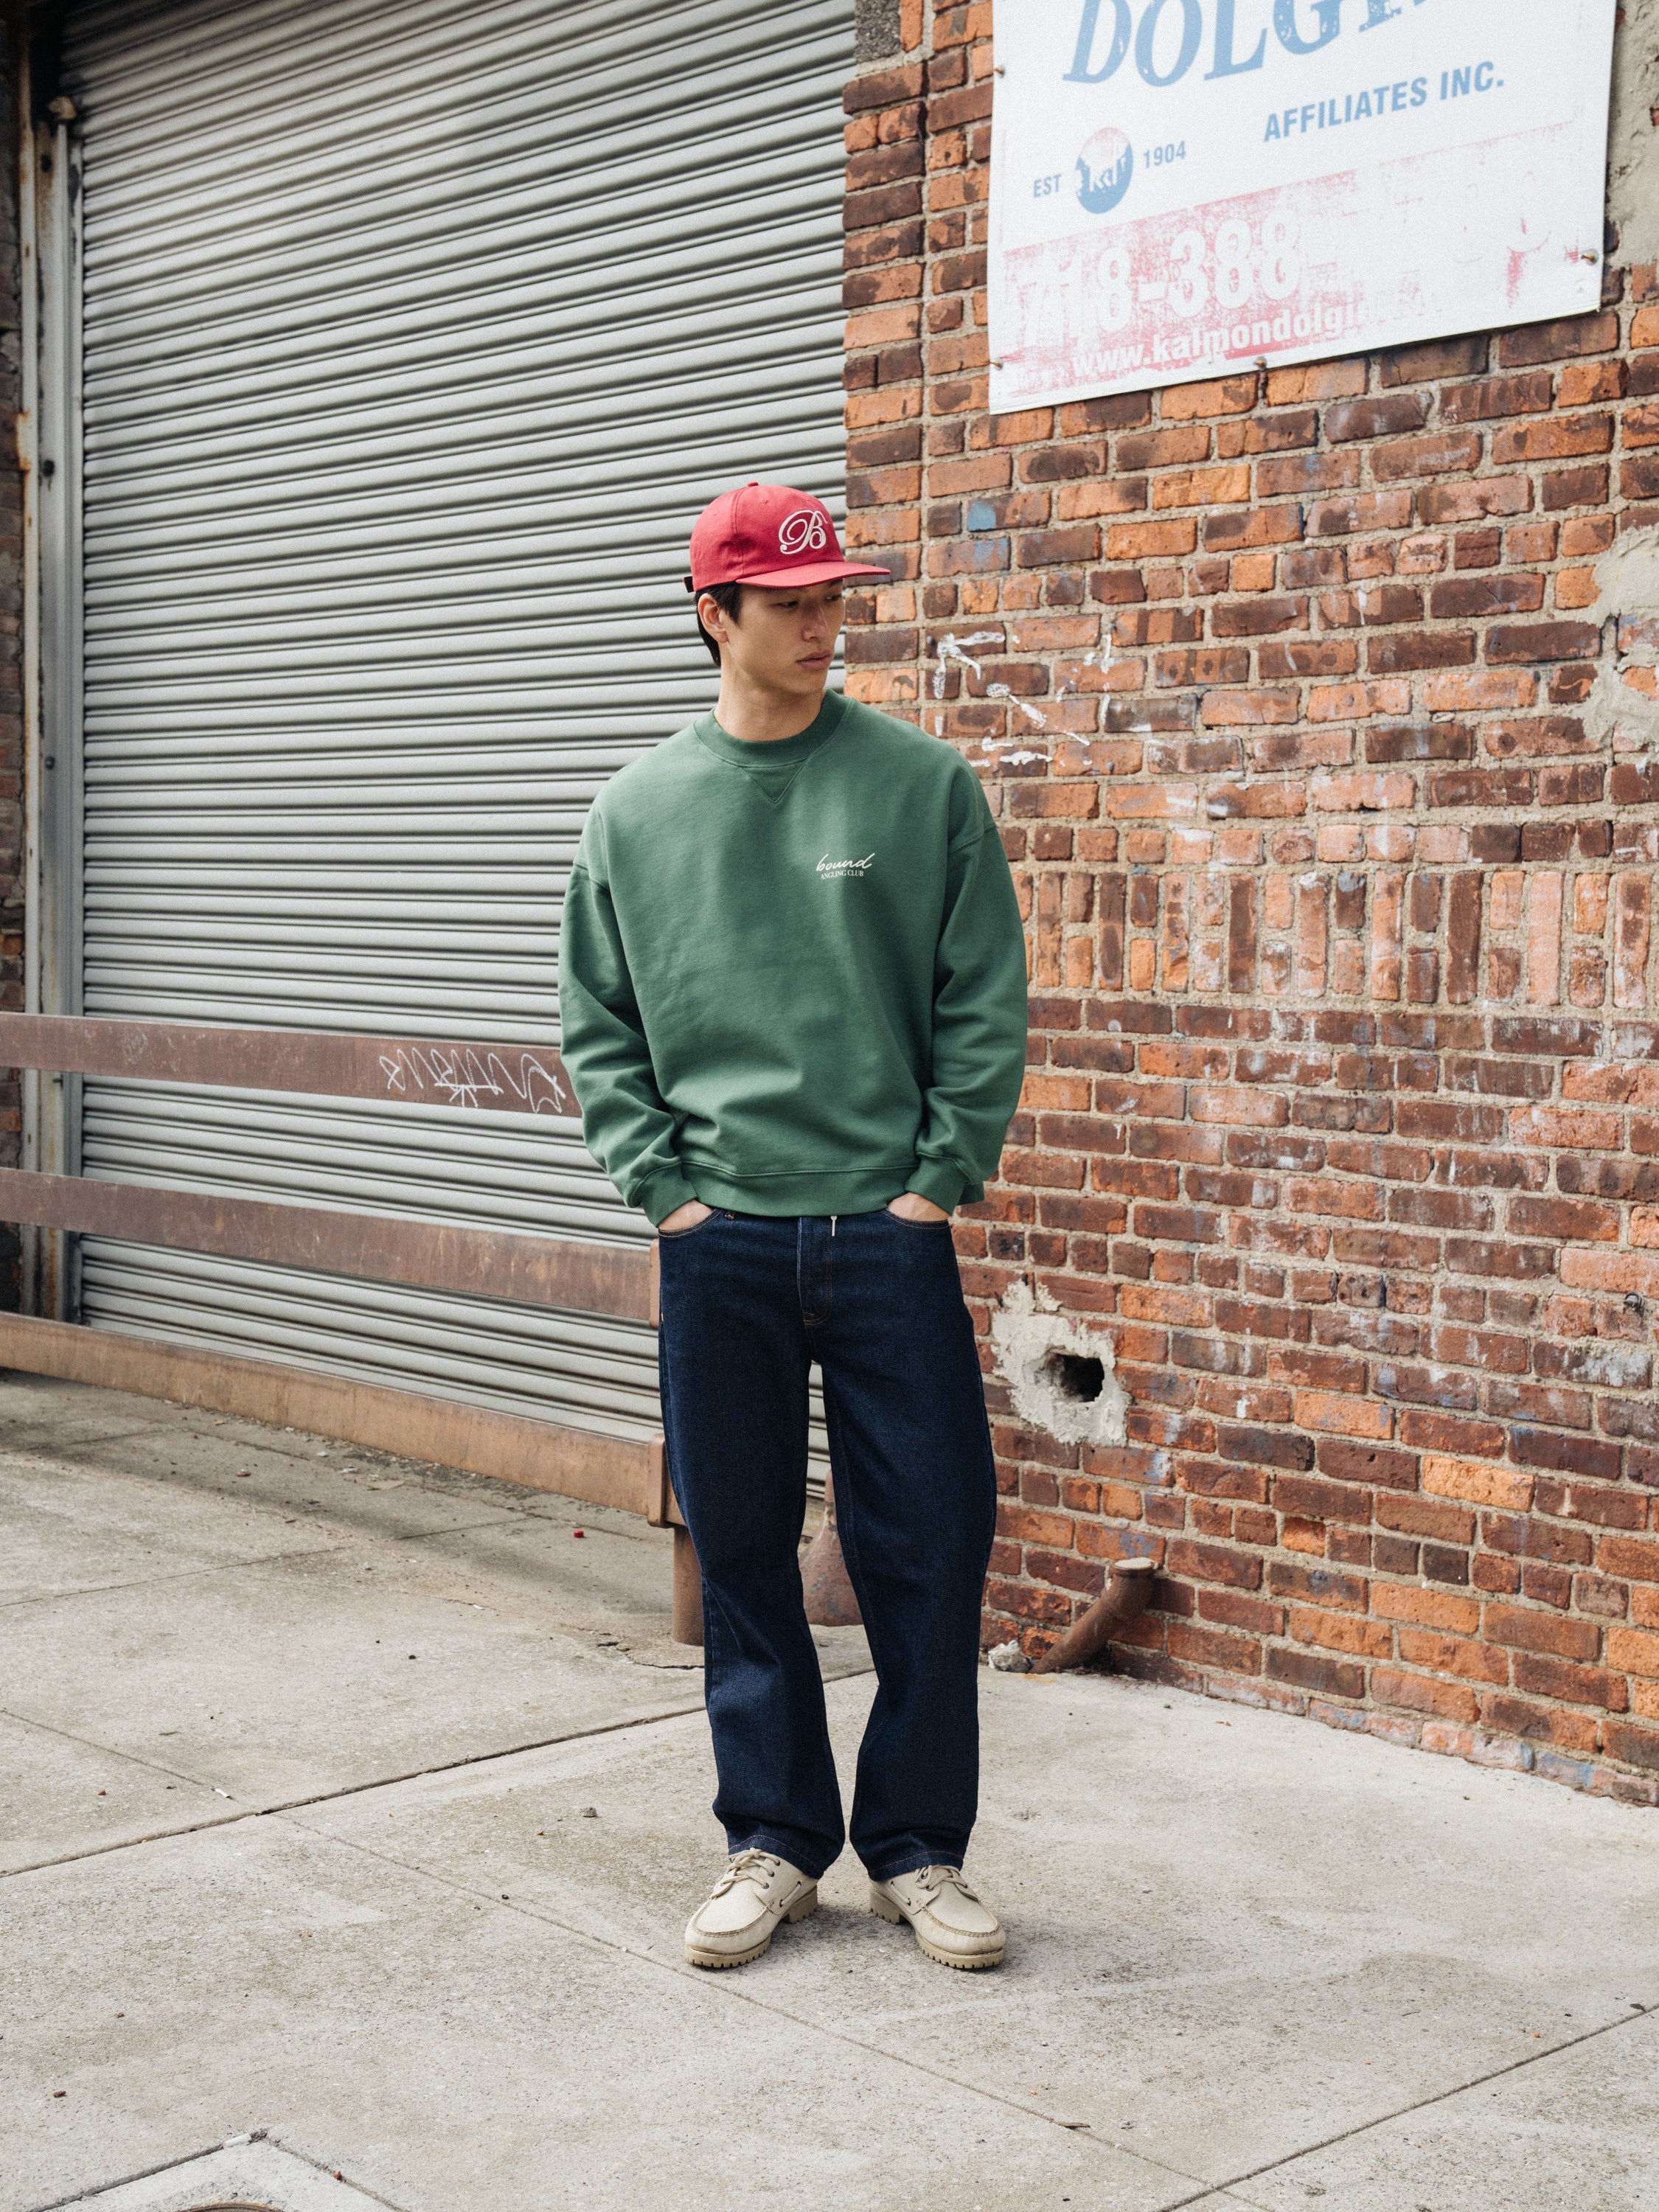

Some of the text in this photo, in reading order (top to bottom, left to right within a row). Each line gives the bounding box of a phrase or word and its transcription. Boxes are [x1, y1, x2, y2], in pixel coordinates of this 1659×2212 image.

[1062, 0, 1425, 88] DOLG
[1263, 60, 1505, 142] AFFILIATES INC.
[1034, 173, 1062, 198] EST
[1144, 140, 1186, 169] 1904
[815, 852, 876, 872] bound
[821, 869, 864, 880] ANGLING CLUB
